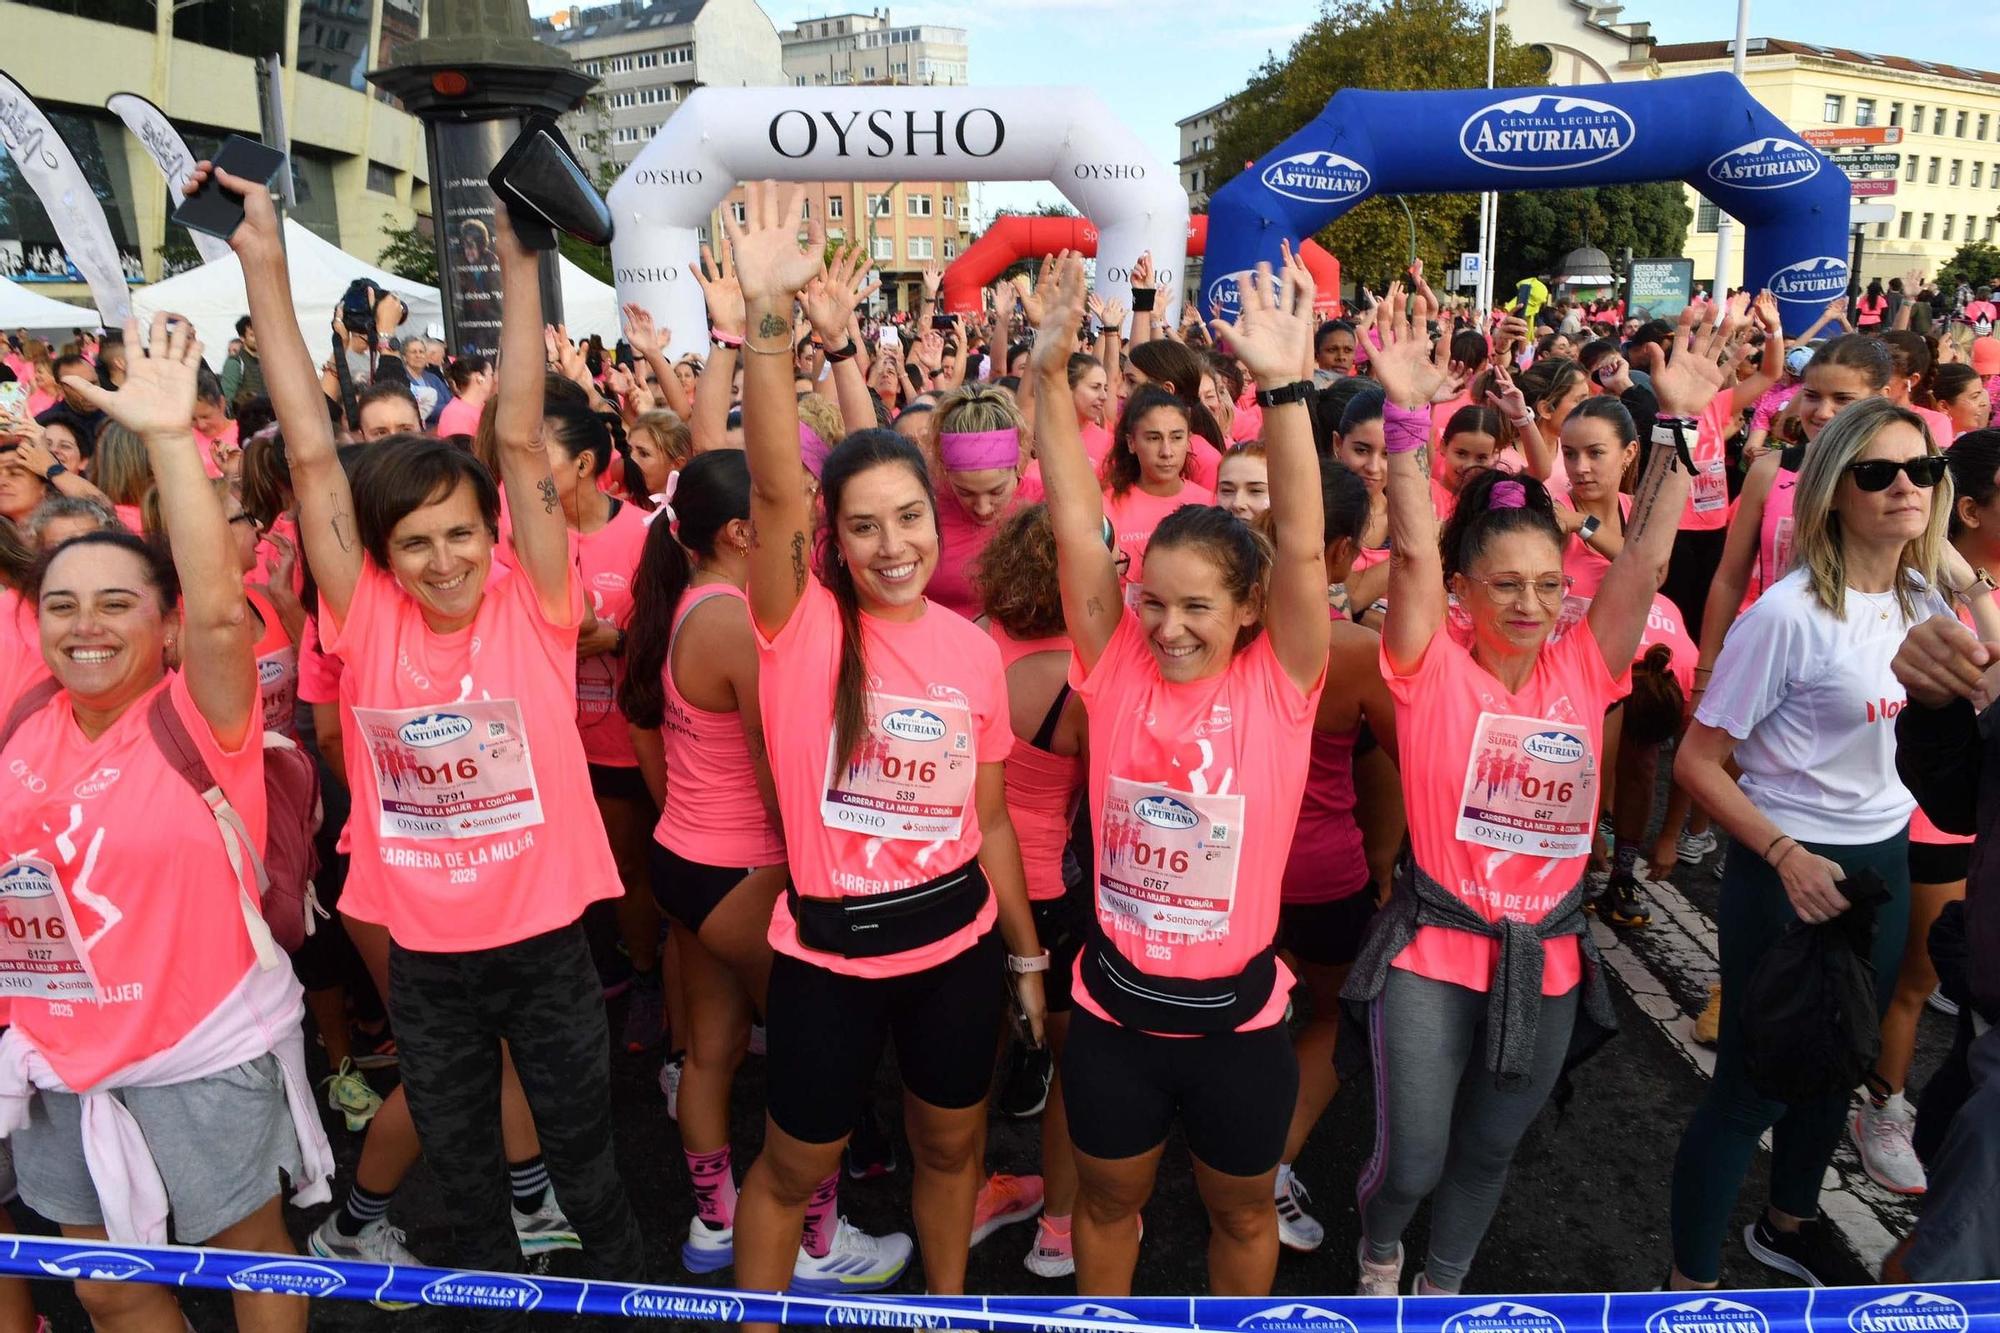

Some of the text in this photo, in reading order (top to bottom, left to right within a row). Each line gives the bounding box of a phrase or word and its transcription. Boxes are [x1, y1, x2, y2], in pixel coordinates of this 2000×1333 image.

[1501, 115, 1617, 127] CENTRAL LECHERA
[768, 108, 1005, 158] OYSHO
[1472, 120, 1621, 152] ASTURIANA
[1737, 155, 1774, 165] CENTRAL
[1874, 153, 1897, 161] Nelle
[1074, 164, 1145, 180] OYSHO
[1289, 165, 1363, 177] CENTRAL LECHERA
[1717, 159, 1815, 179] ASTURIANA
[1862, 163, 1896, 171] Outeiro
[635, 169, 702, 186] OYSHO
[1270, 167, 1361, 192] ASTURIANA
[617, 266, 679, 284] OYSHO
[1108, 267, 1172, 284] OYO
[403, 723, 468, 743] ASTURIANA
[887, 717, 941, 736] ASTURIANA
[1488, 735, 1518, 749] SUMA
[1528, 738, 1581, 758] ASTURIANA
[417, 758, 478, 785] 016
[882, 757, 936, 783] 016
[437, 791, 465, 804] 5791
[896, 790, 915, 801] 539
[1522, 777, 1574, 803] 016
[396, 803, 423, 815] CARRERA
[424, 807, 434, 815] DE
[435, 807, 444, 815] LA
[446, 802, 472, 814] MUJER
[487, 793, 518, 807] CORUÑA
[842, 795, 874, 807] CARRERA
[876, 800, 885, 808] DE
[886, 803, 895, 811] LA
[896, 804, 919, 814] MUJER
[1107, 800, 1130, 813] SUMA
[473, 812, 522, 828] Santander
[838, 809, 885, 828] OYSHO
[1139, 803, 1193, 825] ASTURIANA
[1480, 812, 1511, 824] CARRERA
[1513, 819, 1523, 828] DE
[1524, 820, 1534, 829] LA
[1535, 809, 1553, 820] 647
[397, 818, 442, 832] OYSHO
[913, 822, 949, 832] Santander
[1475, 825, 1524, 845] OYSHO
[380, 846, 442, 869] CARRERA
[445, 852, 466, 868] DE
[469, 849, 488, 865] LA
[1134, 842, 1189, 873] 016
[450, 868, 477, 884] 2025
[1143, 877, 1169, 891] 6767
[1107, 881, 1129, 893] CARRERA
[1129, 887, 1138, 896] DE
[1138, 890, 1147, 899] LA
[1147, 891, 1171, 903] MUJER
[1185, 899, 1214, 908] CORUÑA
[1504, 894, 1540, 911] DE LA
[9, 917, 65, 940] 016
[1166, 914, 1212, 927] Santander
[1145, 928, 1163, 942] DE
[1168, 931, 1184, 945] LA
[27, 949, 52, 961] 6127
[1146, 944, 1171, 960] 2025
[16, 962, 26, 970] DE
[33, 963, 59, 972] MUJER
[59, 981, 93, 991] Santan
[104, 982, 143, 1003] UJER
[49, 1002, 74, 1017] 2025
[432, 1294, 511, 1307] CENTRAL LECHERA
[434, 1284, 535, 1307] ASTURIANA
[633, 1295, 735, 1321] ASTURIANA
[835, 1306, 940, 1328] ASTURIANA
[1659, 1317, 1760, 1333] ASTURIANA
[1861, 1310, 1962, 1332] ASTURIANA
